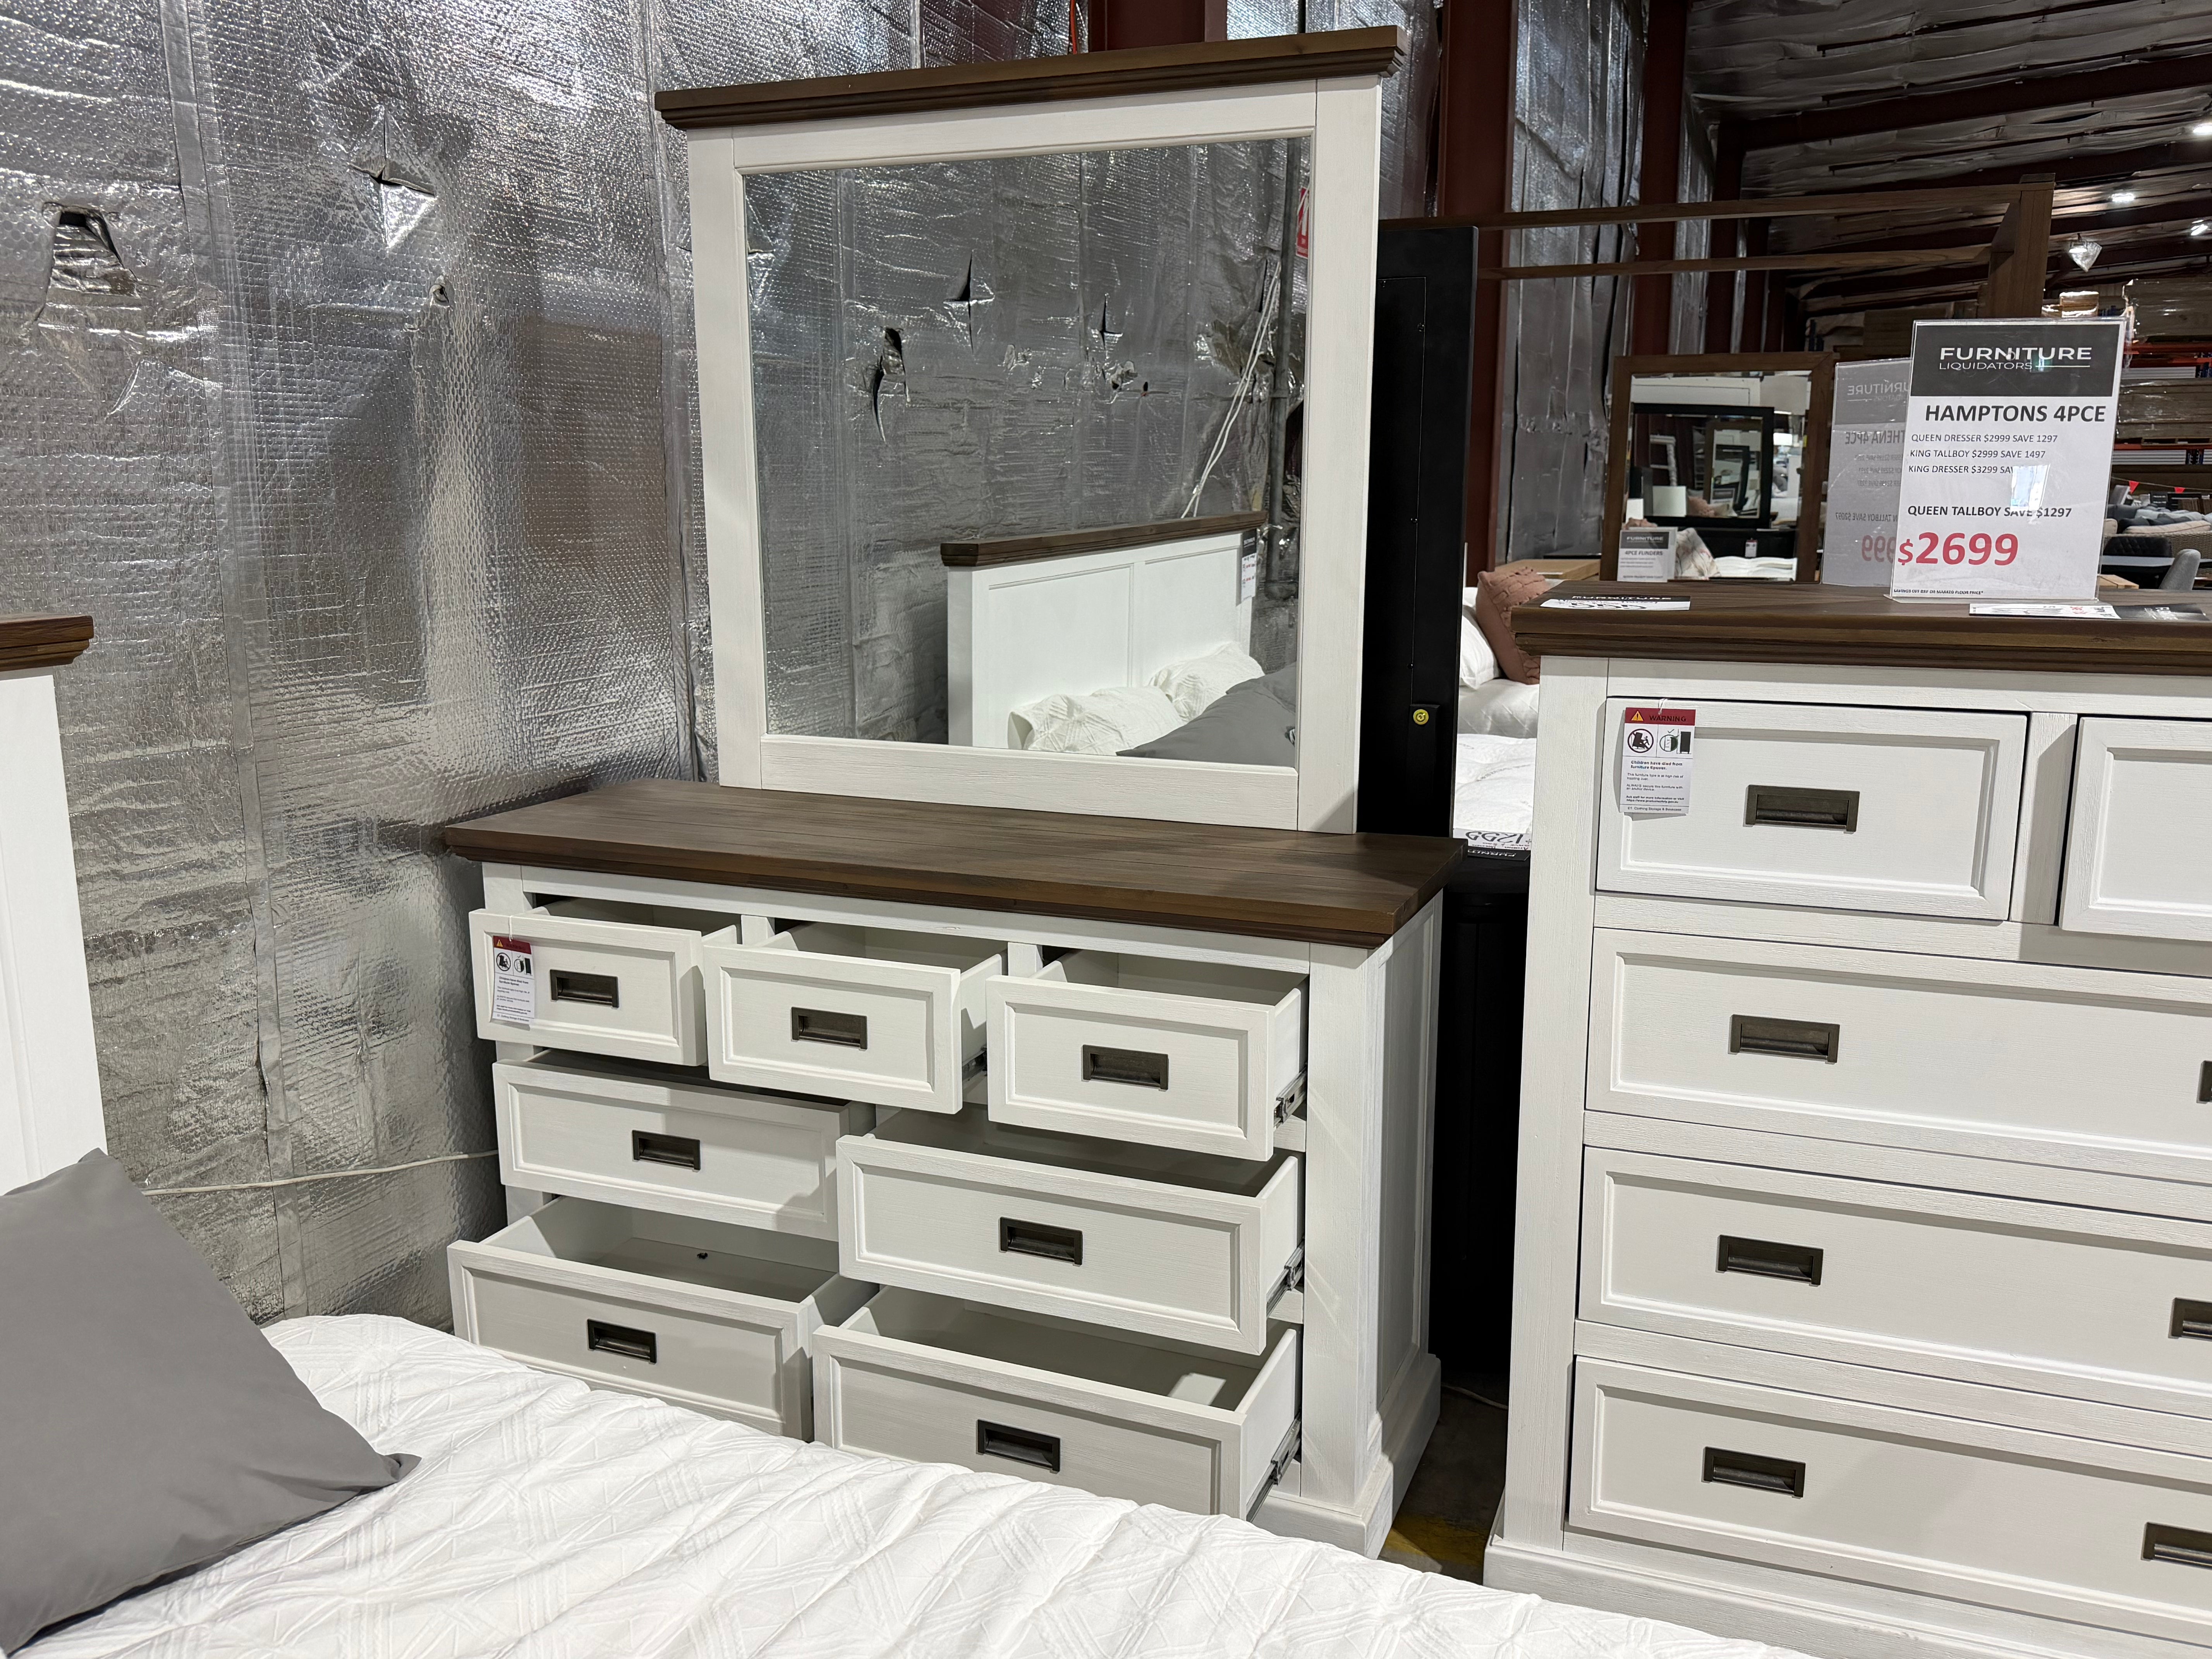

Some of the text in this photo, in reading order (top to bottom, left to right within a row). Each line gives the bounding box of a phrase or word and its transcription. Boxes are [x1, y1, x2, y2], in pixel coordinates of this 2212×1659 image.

[1940, 347, 2092, 360] FURNITURE
[1939, 362, 2032, 370] LIQUIDATORS
[1925, 405, 2106, 422] HAMPTONS 4PCE
[1911, 434, 1941, 443] QUEEN
[1944, 434, 1981, 442] DRESSER
[1984, 434, 2010, 443] $2999
[1972, 450, 1998, 459] $2999
[2025, 450, 2046, 459] 1497
[1971, 465, 1998, 475] $3299
[1908, 505, 1948, 516] QUEEN
[1952, 506, 2001, 516] TALLBOY
[2036, 507, 2072, 518] $1297
[1898, 532, 2018, 566] $2699
